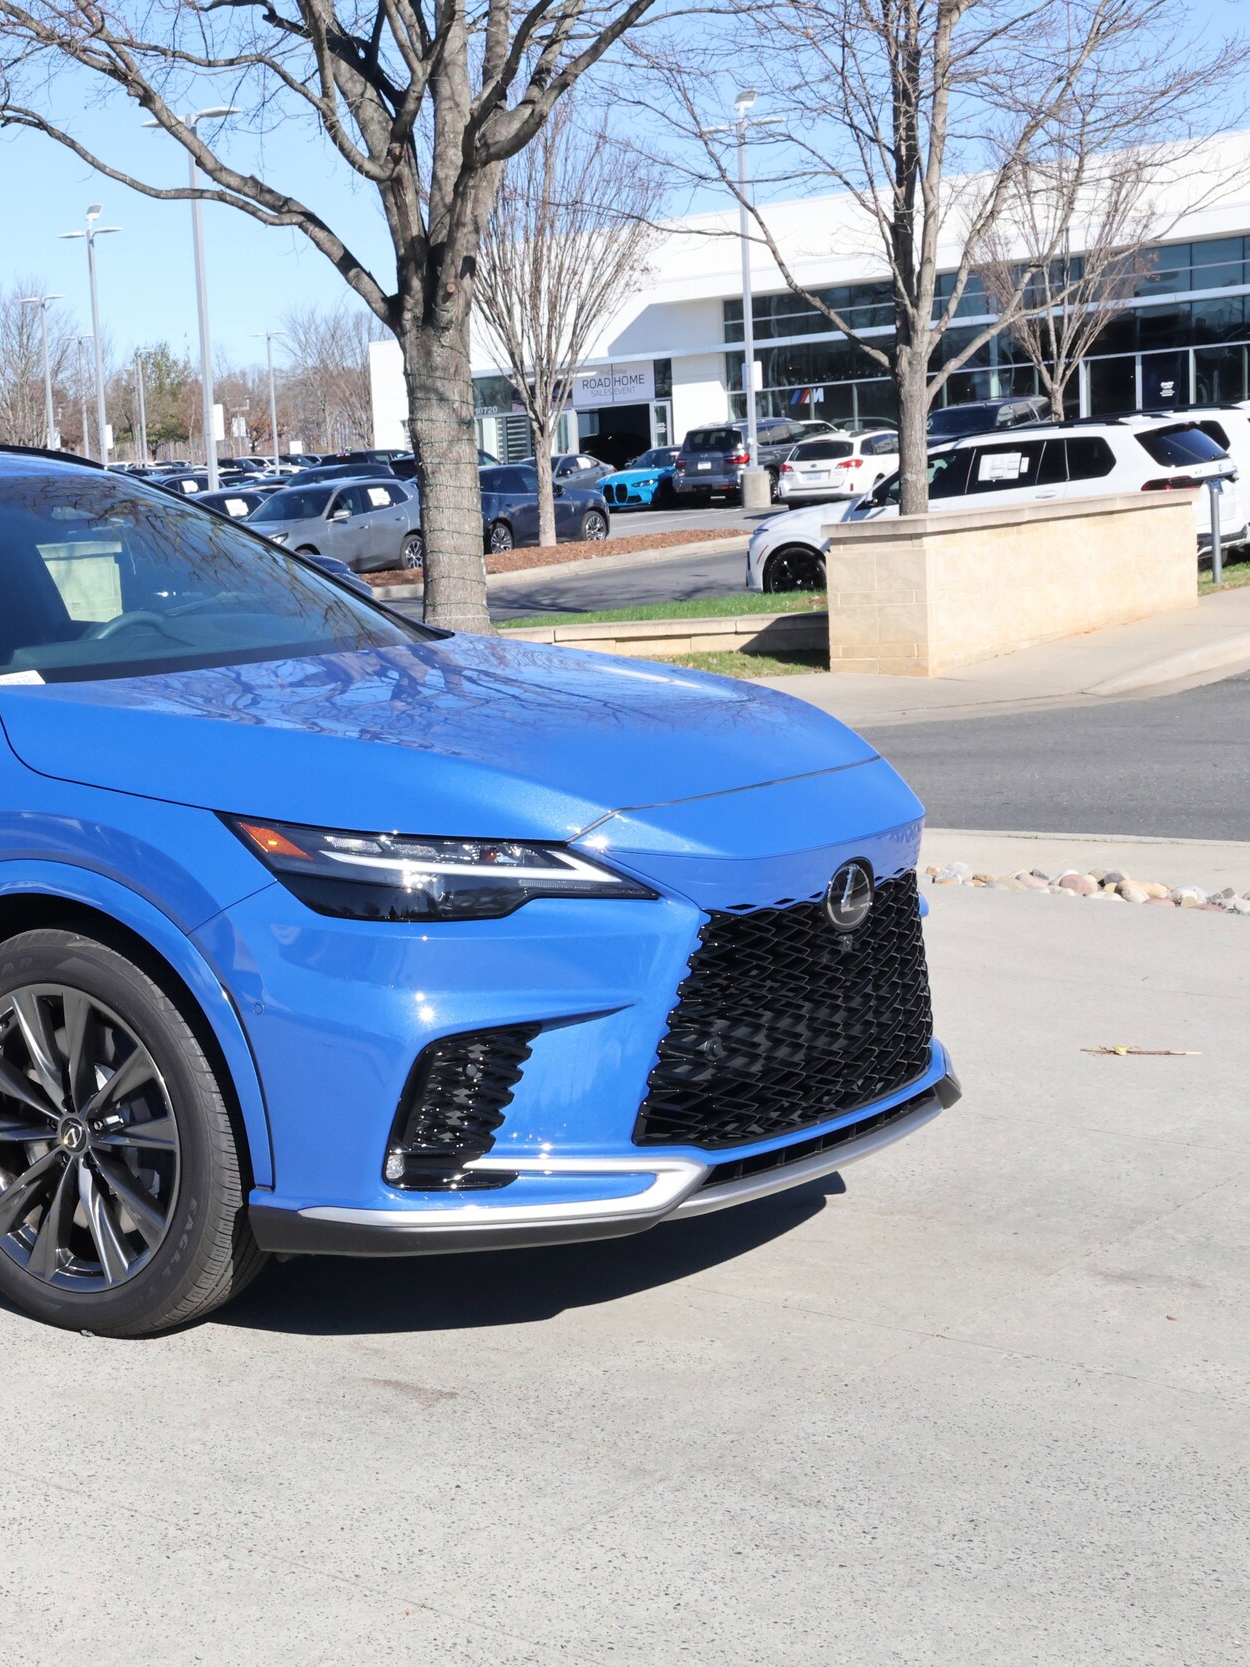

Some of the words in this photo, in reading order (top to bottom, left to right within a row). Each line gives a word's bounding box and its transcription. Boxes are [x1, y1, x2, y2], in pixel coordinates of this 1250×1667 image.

[582, 377, 611, 390] ROAD
[613, 373, 645, 387] HOME
[591, 388, 612, 398] SALES
[614, 386, 636, 395] EVENT
[161, 1195, 198, 1277] EAGLE
